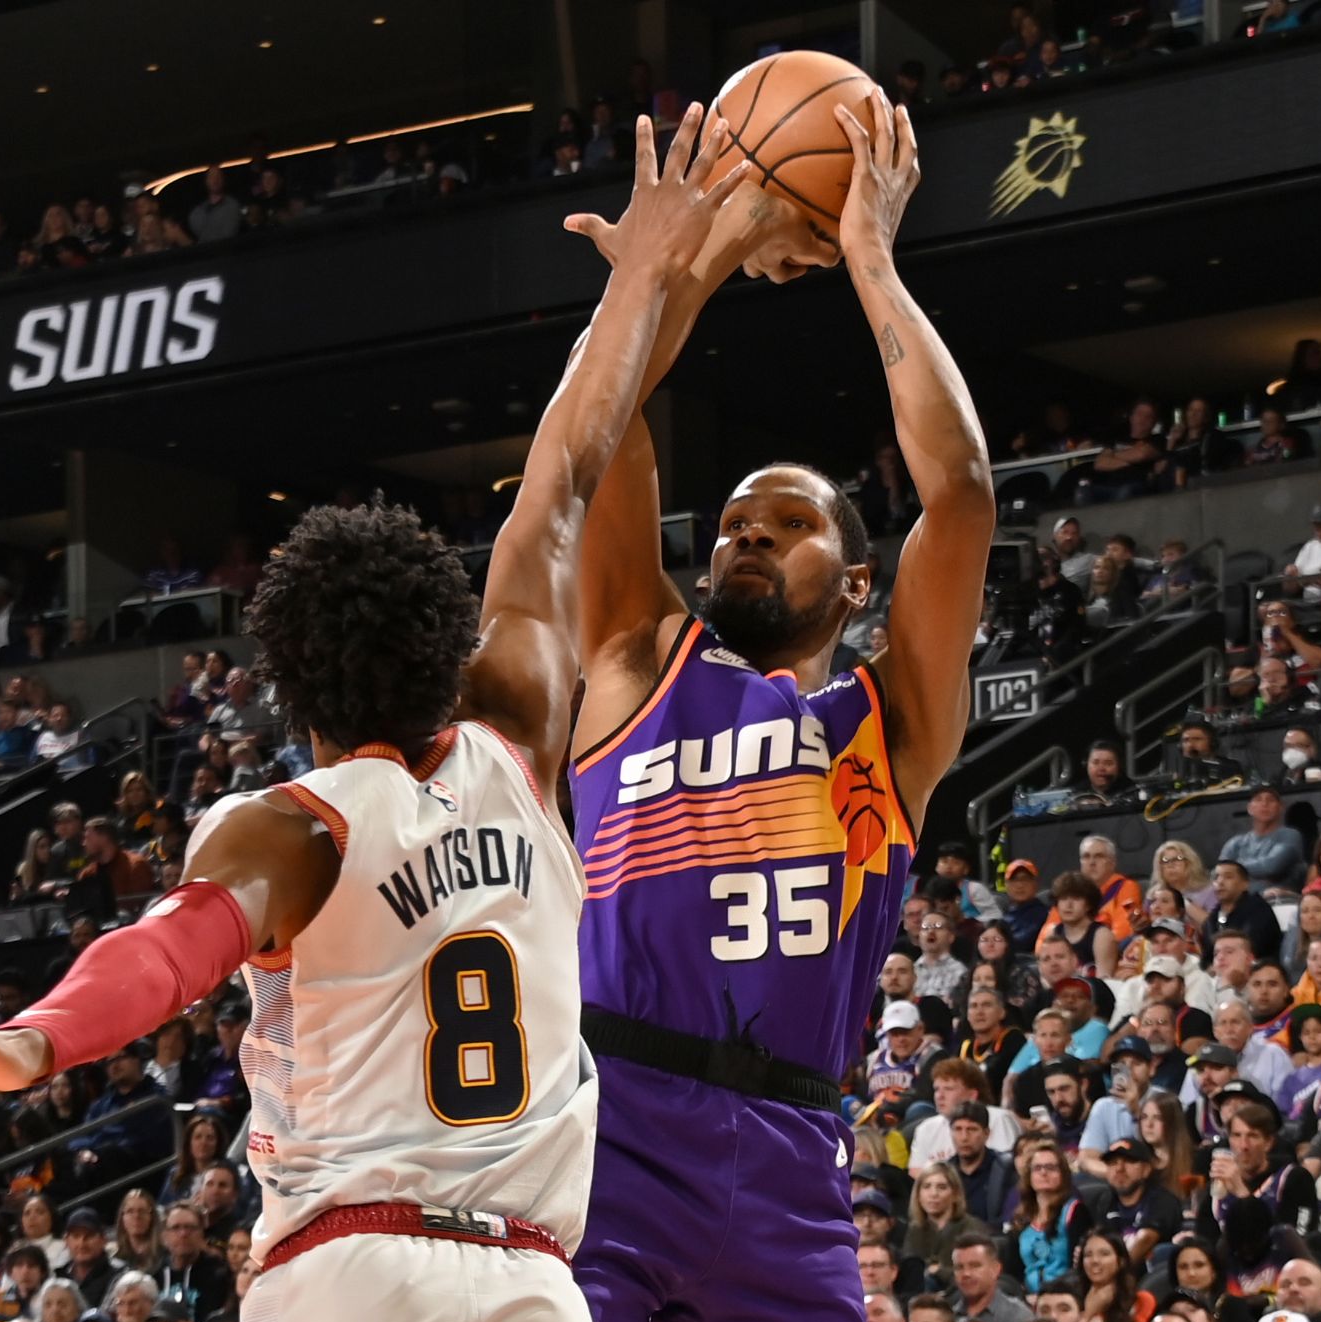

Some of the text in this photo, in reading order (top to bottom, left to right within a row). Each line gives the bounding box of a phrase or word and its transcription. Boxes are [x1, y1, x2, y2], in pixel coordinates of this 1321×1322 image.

[9, 276, 224, 392] SUNS
[710, 646, 749, 667] NIKE
[806, 676, 856, 701] PayPal
[618, 716, 833, 805] SUNS
[378, 828, 534, 930] WATSON
[709, 864, 831, 962] 35
[423, 930, 530, 1126] 8
